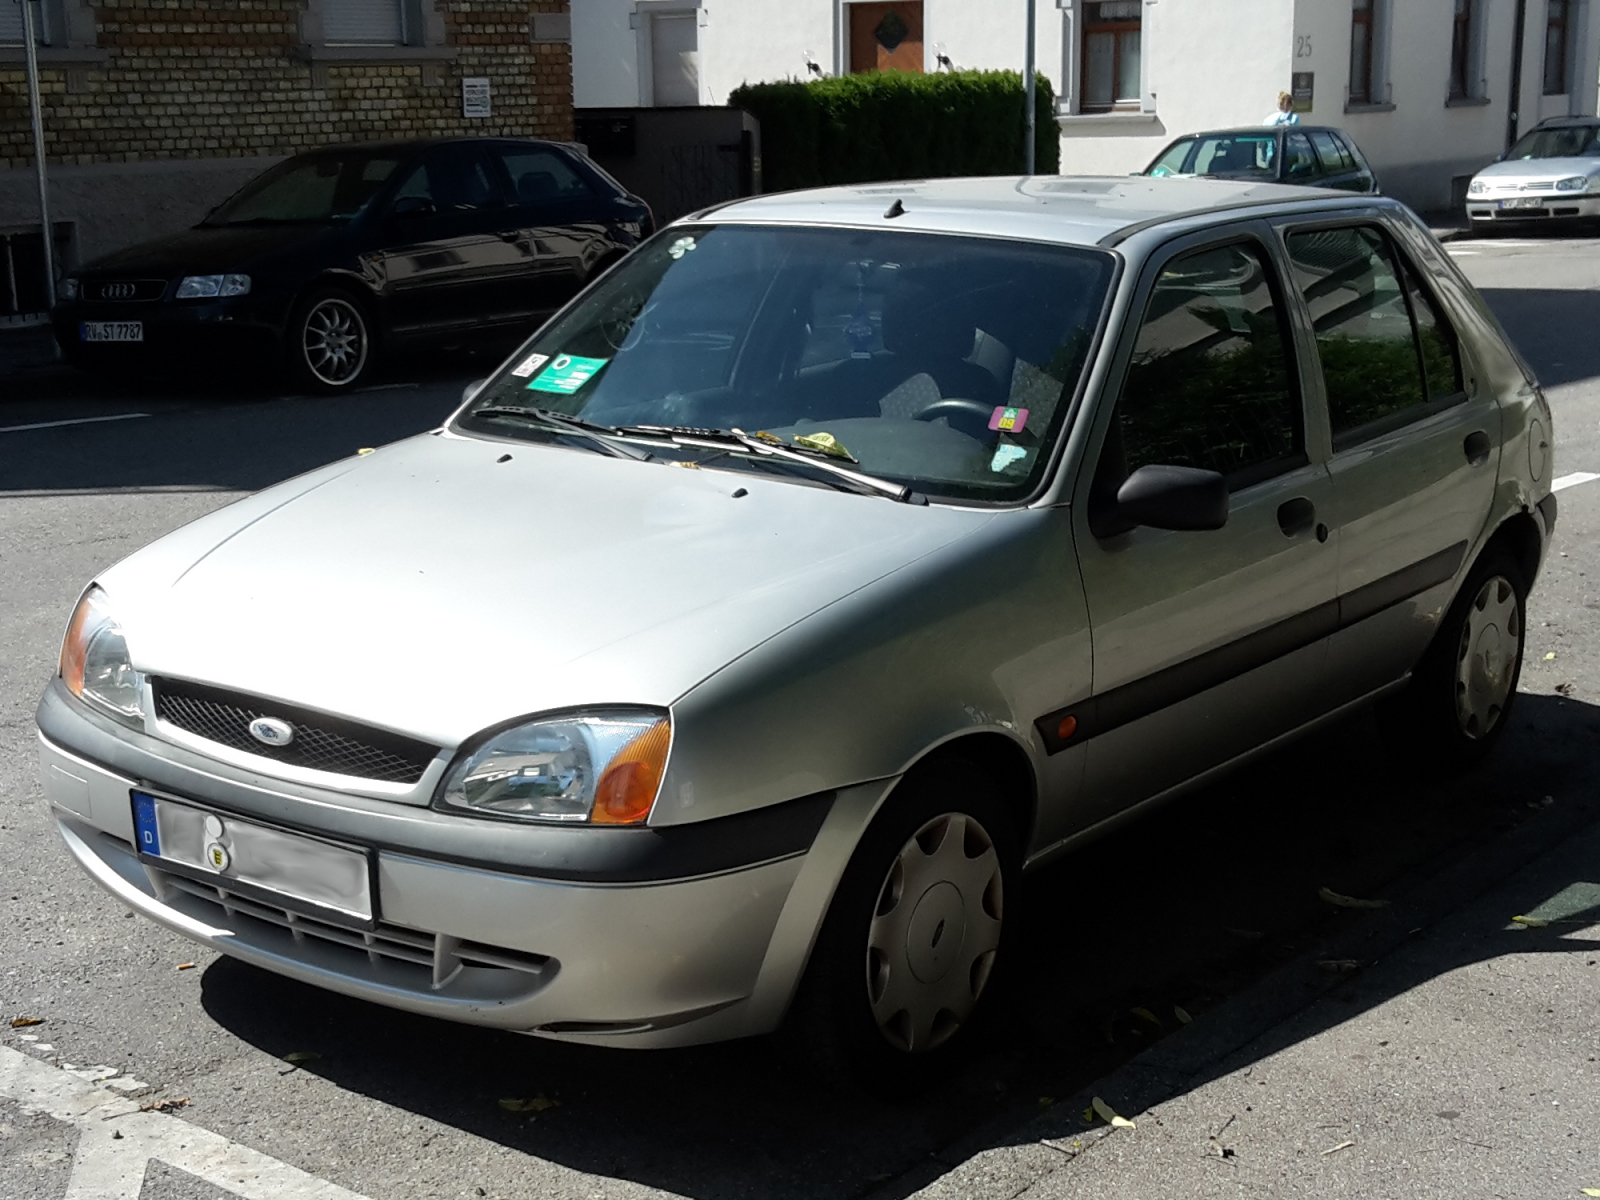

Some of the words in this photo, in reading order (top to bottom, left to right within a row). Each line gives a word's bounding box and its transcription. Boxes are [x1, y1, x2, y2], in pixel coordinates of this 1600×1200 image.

[1297, 35, 1312, 57] 25
[103, 323, 115, 339] ST
[117, 323, 141, 339] 7787
[144, 830, 153, 844] D
